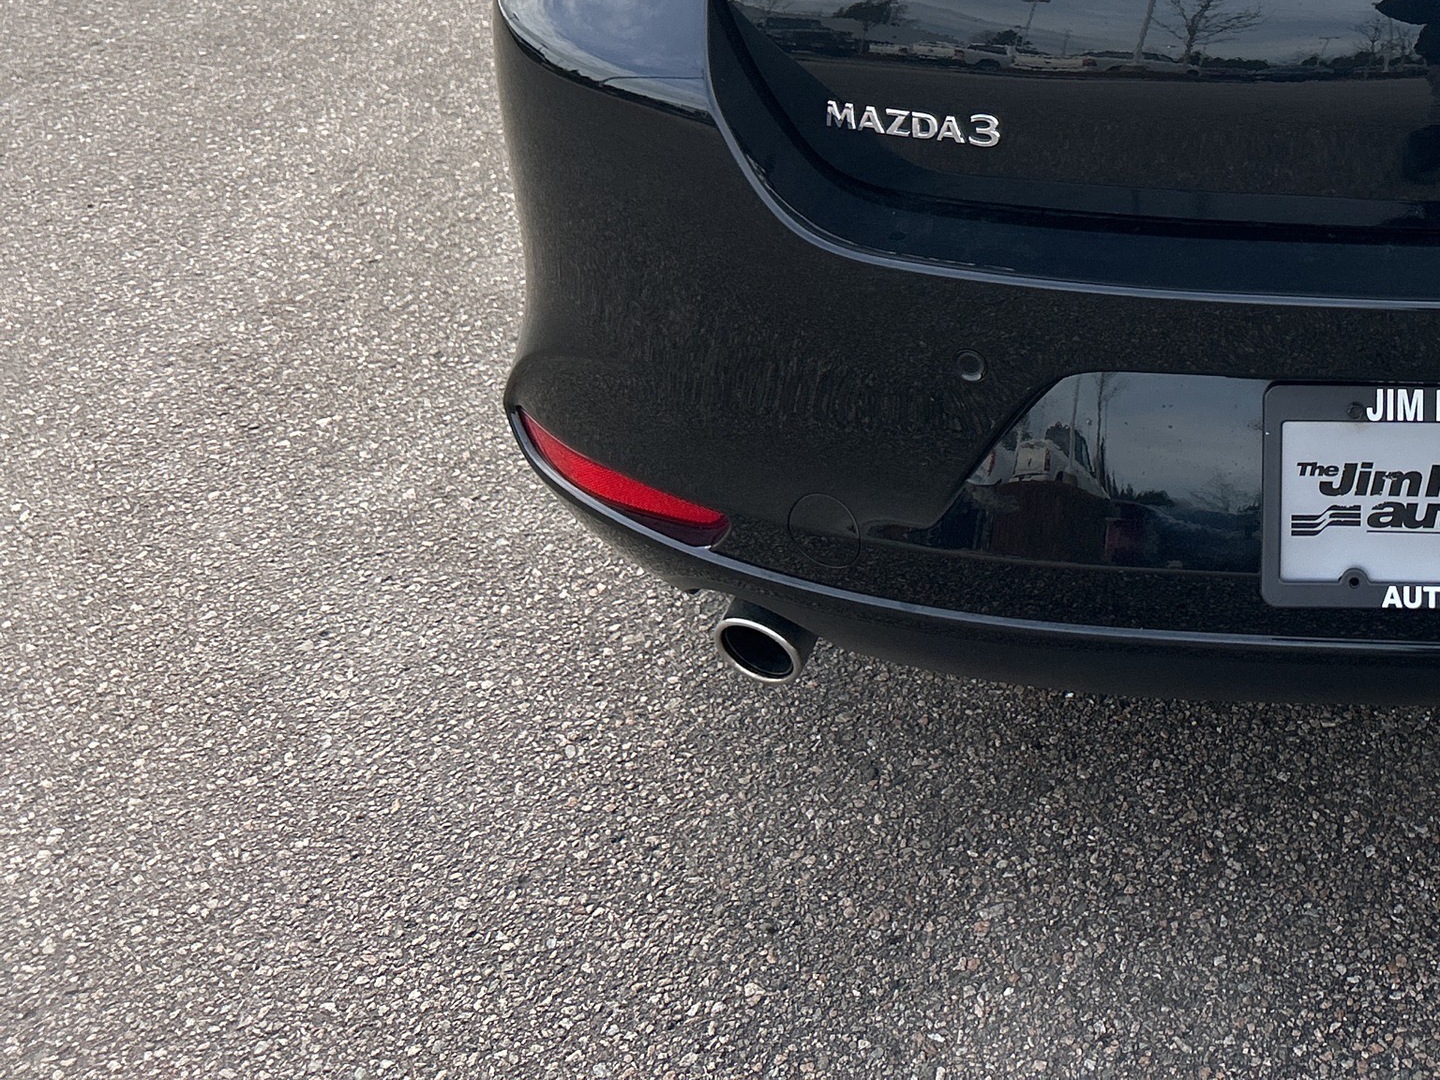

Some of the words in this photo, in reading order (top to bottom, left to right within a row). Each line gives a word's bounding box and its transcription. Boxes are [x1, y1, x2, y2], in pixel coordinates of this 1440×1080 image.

[826, 99, 1001, 148] MAZDA3
[1366, 388, 1424, 422] JIM
[1297, 461, 1339, 477] The
